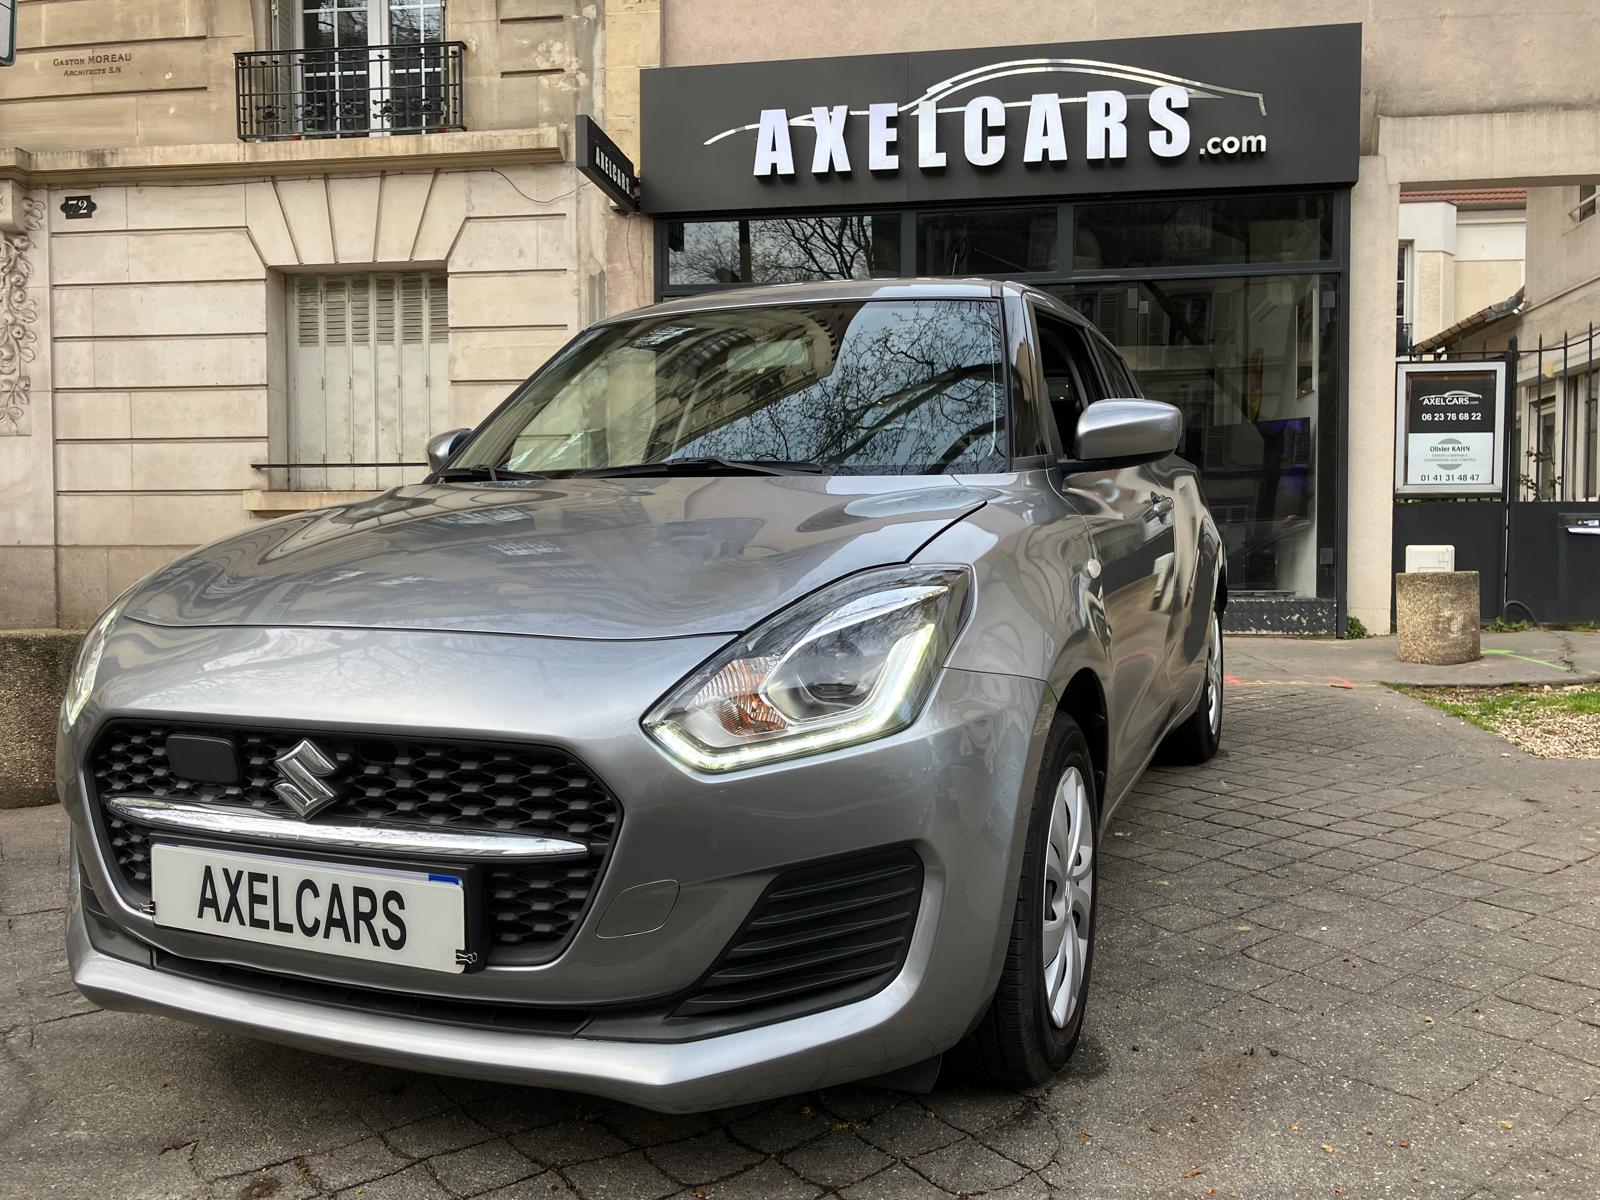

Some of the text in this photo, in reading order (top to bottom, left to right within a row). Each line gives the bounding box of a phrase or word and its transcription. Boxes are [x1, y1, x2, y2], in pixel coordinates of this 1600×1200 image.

[88, 53, 132, 64] MOREAU
[68, 200, 88, 214] 72
[1446, 412, 1456, 420] 76
[1458, 412, 1469, 420] 68
[1471, 412, 1481, 420] 22
[197, 864, 408, 951] AXELCARS
